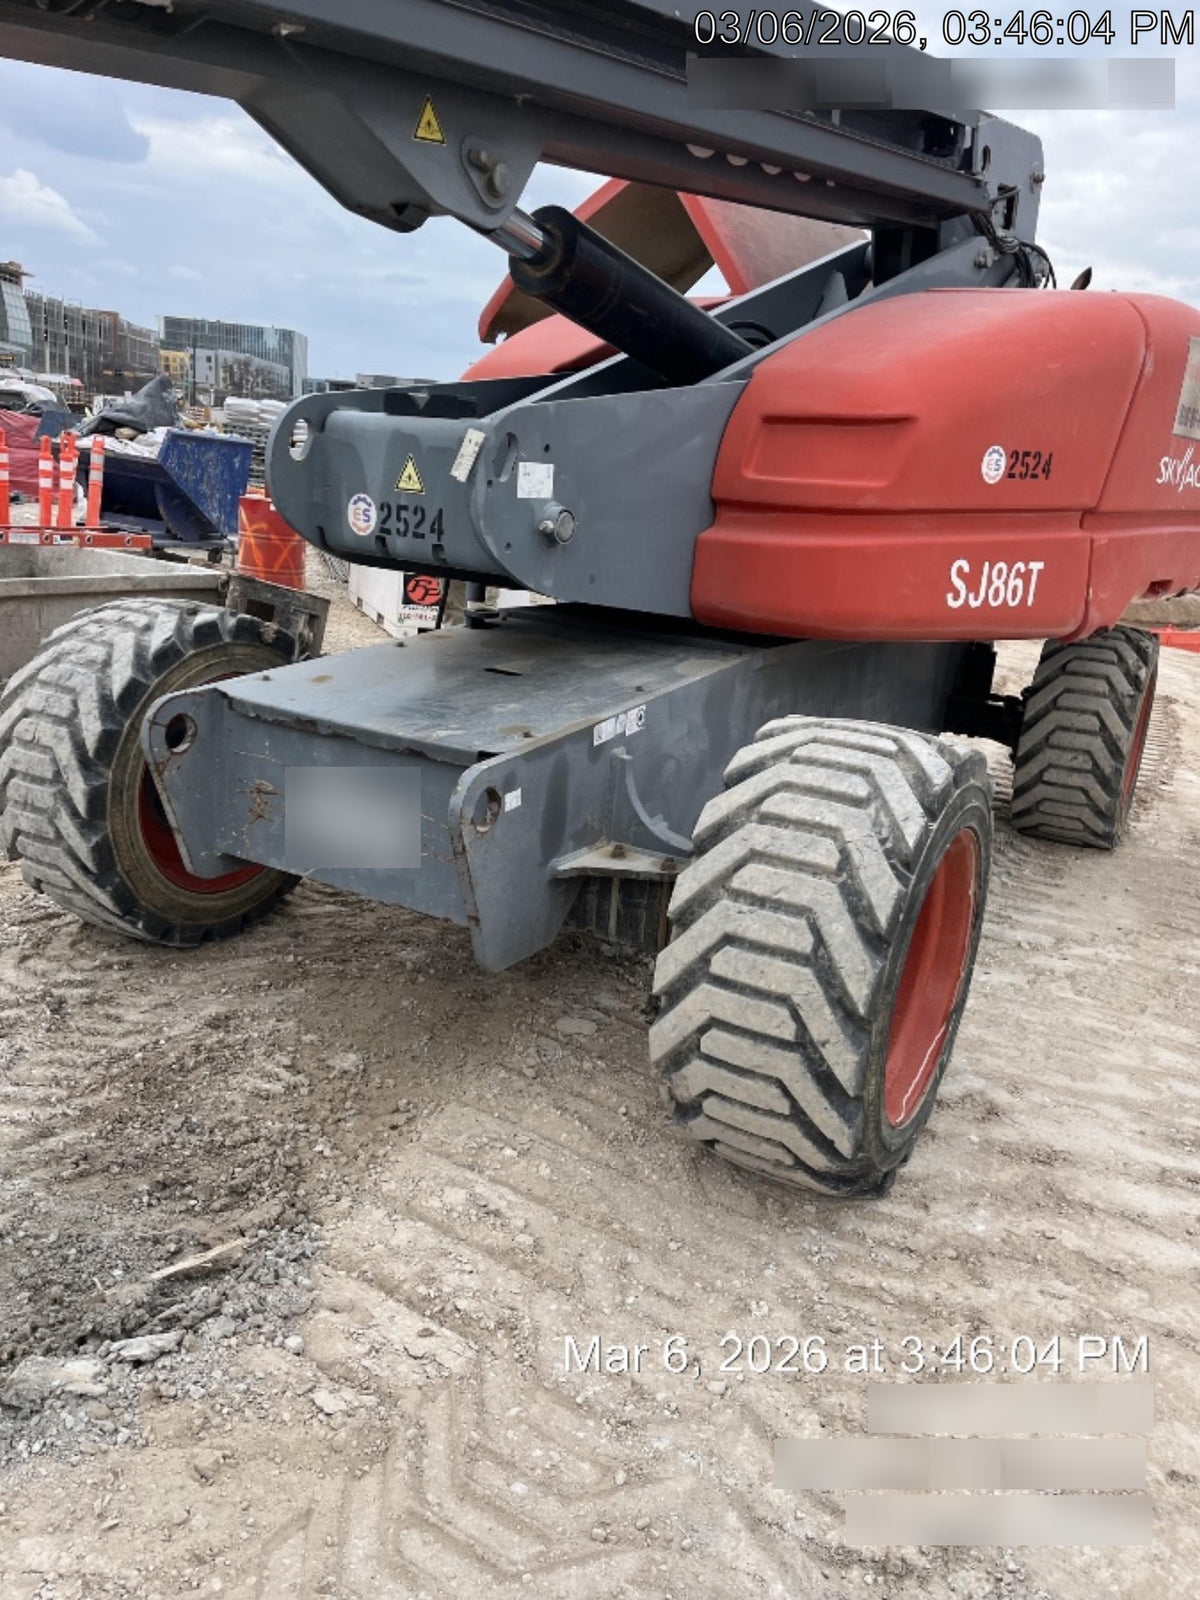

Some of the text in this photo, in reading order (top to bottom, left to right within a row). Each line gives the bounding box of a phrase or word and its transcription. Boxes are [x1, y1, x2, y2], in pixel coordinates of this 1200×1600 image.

[1007, 450, 1053, 481] 2524
[379, 501, 444, 543] 2524
[946, 558, 1045, 609] SJ86T
